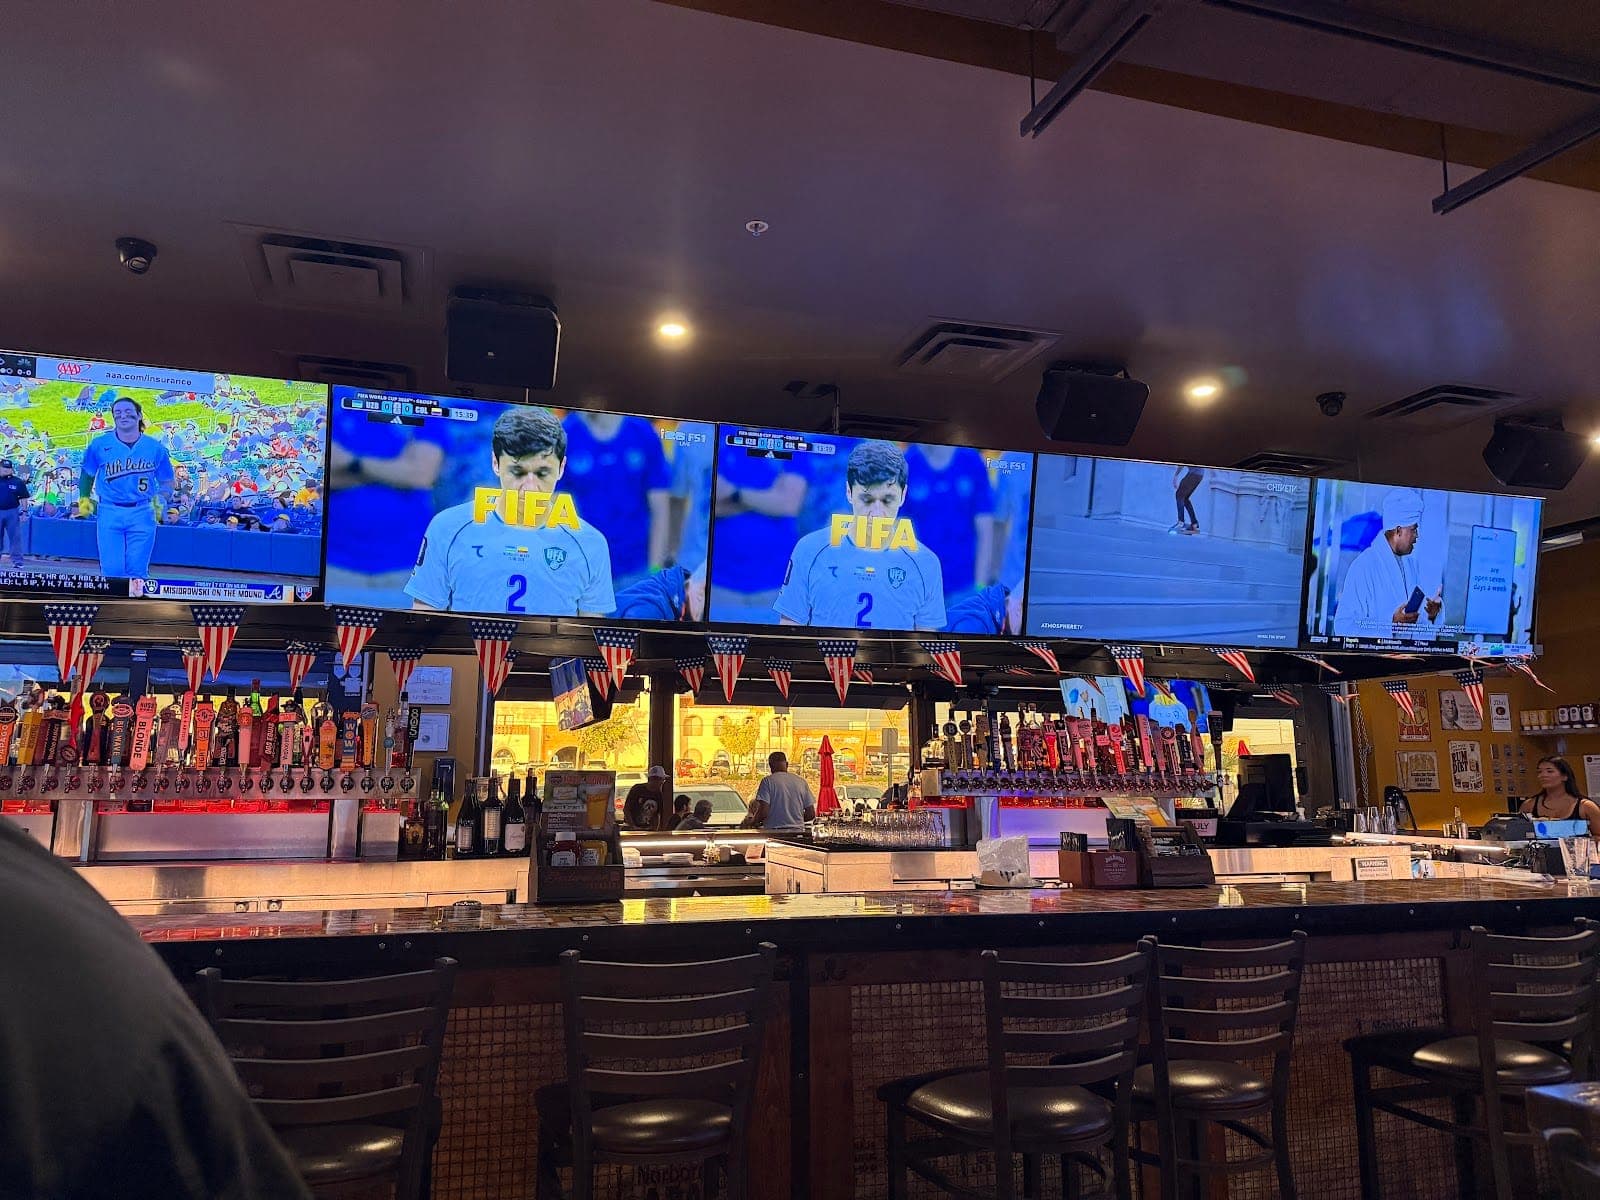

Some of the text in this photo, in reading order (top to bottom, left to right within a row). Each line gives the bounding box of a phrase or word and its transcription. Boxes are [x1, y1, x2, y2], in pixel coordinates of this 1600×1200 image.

[106, 372, 192, 386] aaa.com/insurance
[139, 478, 148, 492] 5
[474, 486, 581, 531] FIFA
[831, 514, 918, 552] FIFA
[224, 588, 237, 597] THE
[507, 574, 528, 612] 2
[856, 592, 874, 627] 2
[112, 720, 124, 756] BIG WAVE
[344, 722, 356, 748] WOW
[409, 708, 419, 736] 805
[133, 722, 146, 758] BLONDE
